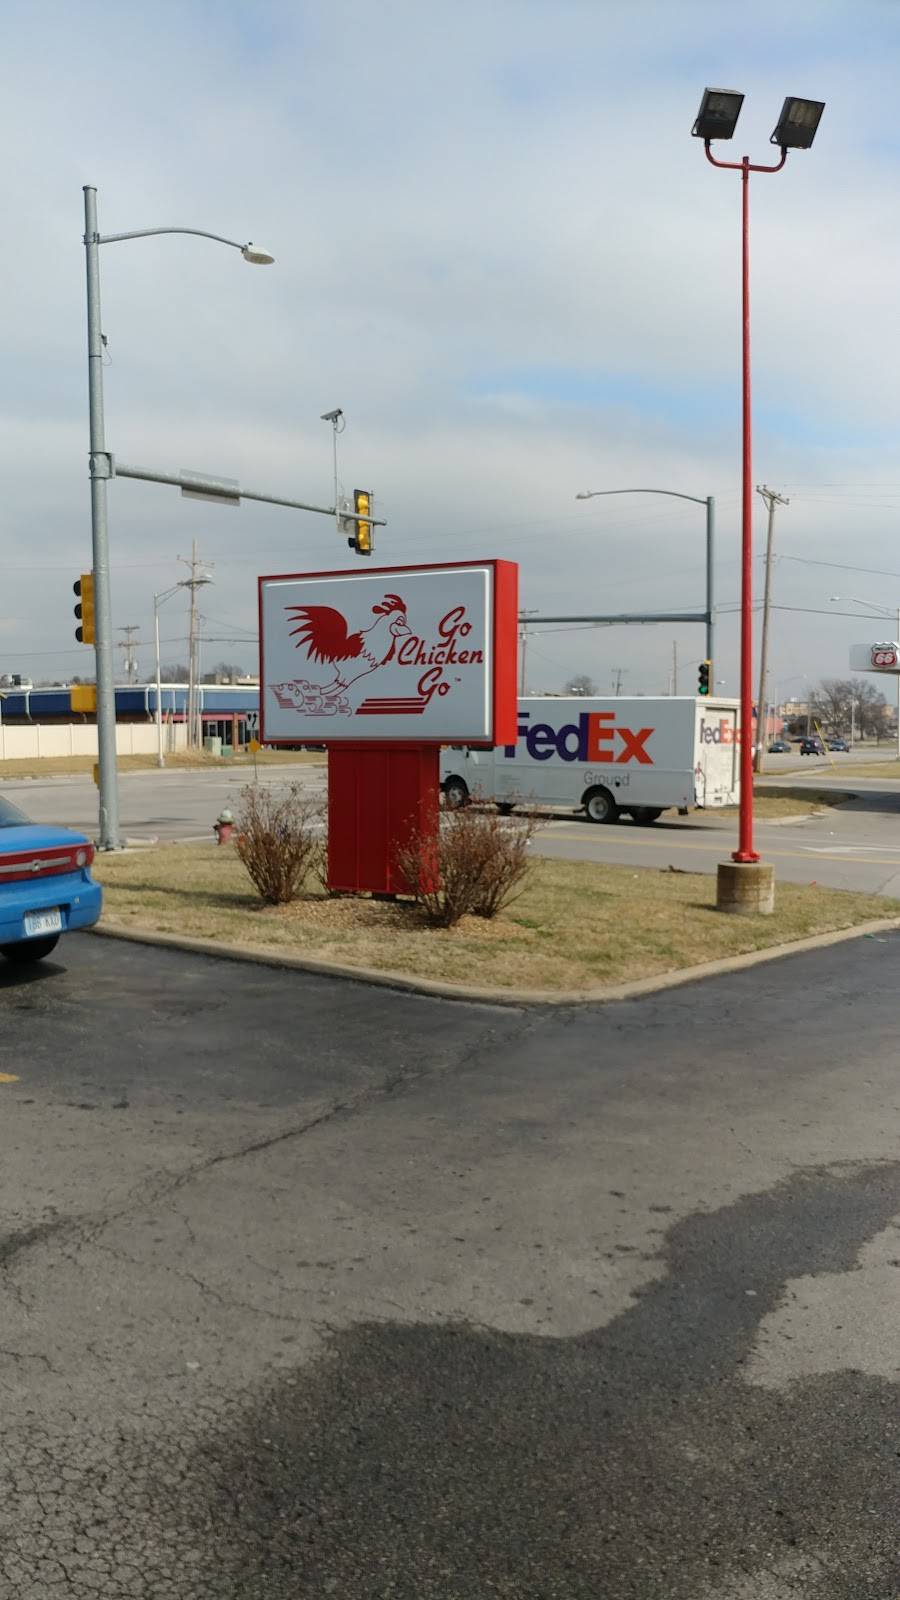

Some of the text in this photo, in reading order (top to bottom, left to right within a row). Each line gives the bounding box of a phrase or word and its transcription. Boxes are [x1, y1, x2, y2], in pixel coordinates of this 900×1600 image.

[437, 606, 472, 648] Go
[398, 636, 484, 665] Chicken
[875, 652, 895, 664] 66
[417, 666, 451, 705] Go
[583, 771, 630, 786] Ground
